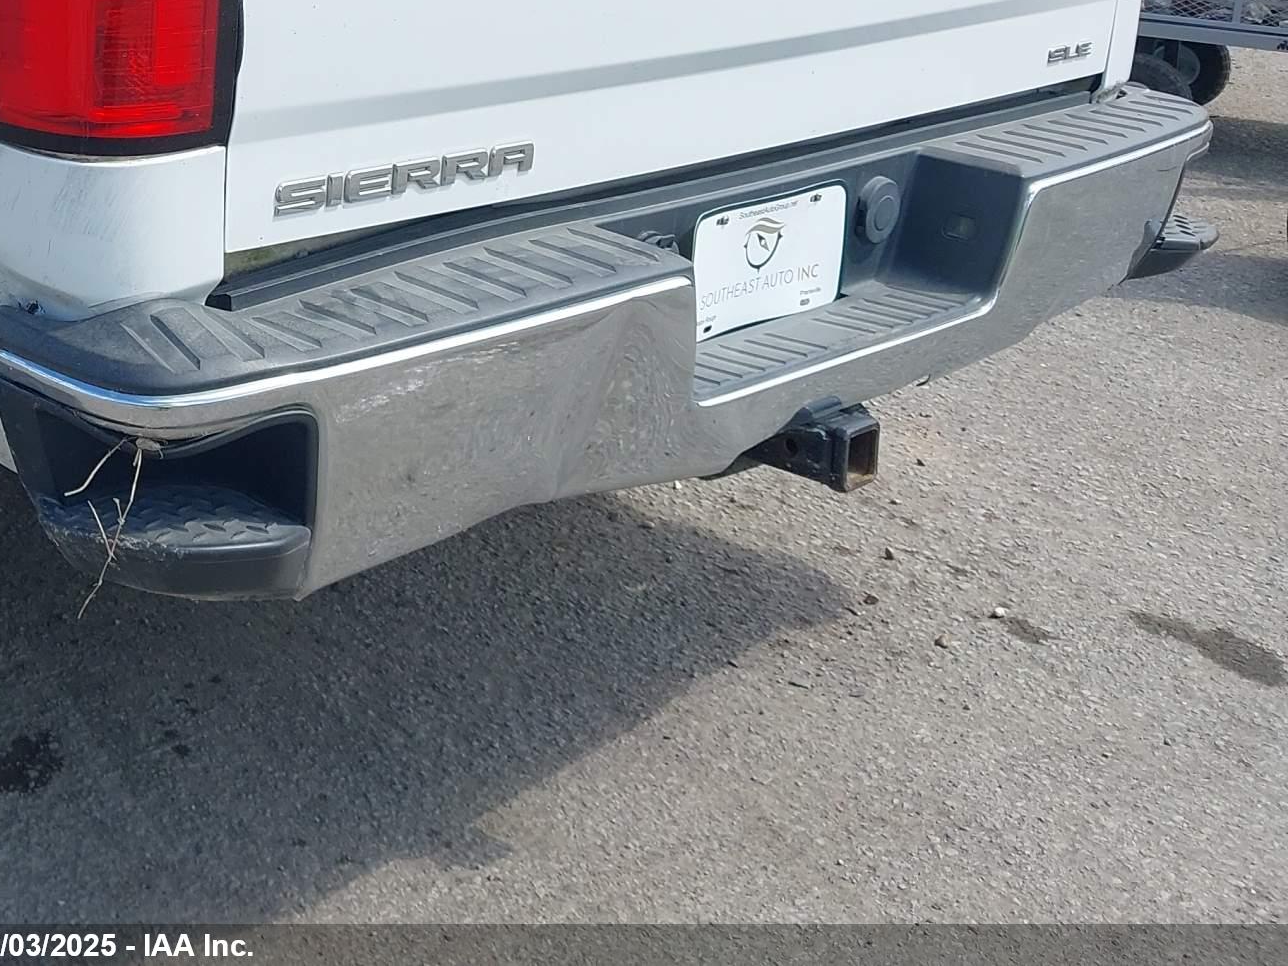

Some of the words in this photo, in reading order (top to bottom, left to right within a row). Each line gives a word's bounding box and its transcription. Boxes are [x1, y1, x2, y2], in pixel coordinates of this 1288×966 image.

[1046, 41, 1094, 65] SLE
[273, 139, 536, 218] SIERRA
[699, 277, 761, 311] SOUTHEAST
[762, 269, 794, 290] AUTO
[797, 263, 820, 283] INC
